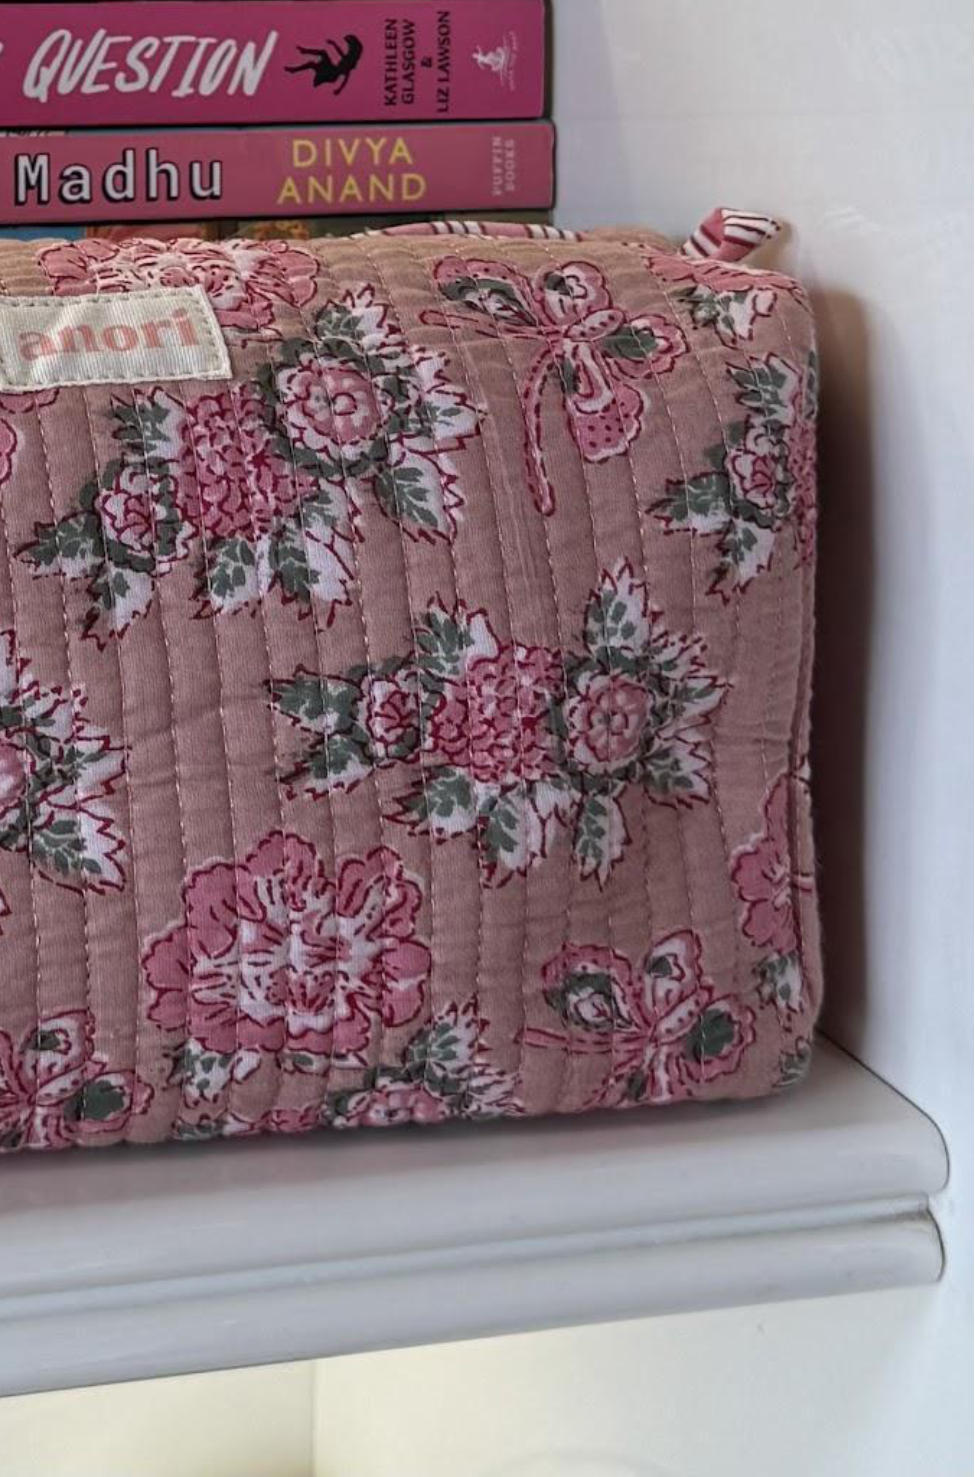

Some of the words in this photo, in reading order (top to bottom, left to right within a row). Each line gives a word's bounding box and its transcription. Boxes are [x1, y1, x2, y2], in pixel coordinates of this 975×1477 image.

[22, 28, 279, 103] QUESTION
[384, 18, 398, 107] KATHLEEN
[401, 19, 416, 105] GLASGOW
[421, 56, 433, 69] &
[437, 10, 451, 83] LAWSON
[437, 86, 450, 114] LIZ
[14, 147, 224, 206] Madhu
[291, 136, 415, 168] DIVYA
[491, 135, 503, 197] PUFFIN
[504, 138, 516, 192] BOOKS
[276, 172, 427, 205] ANAND
[18, 308, 199, 361] anori
